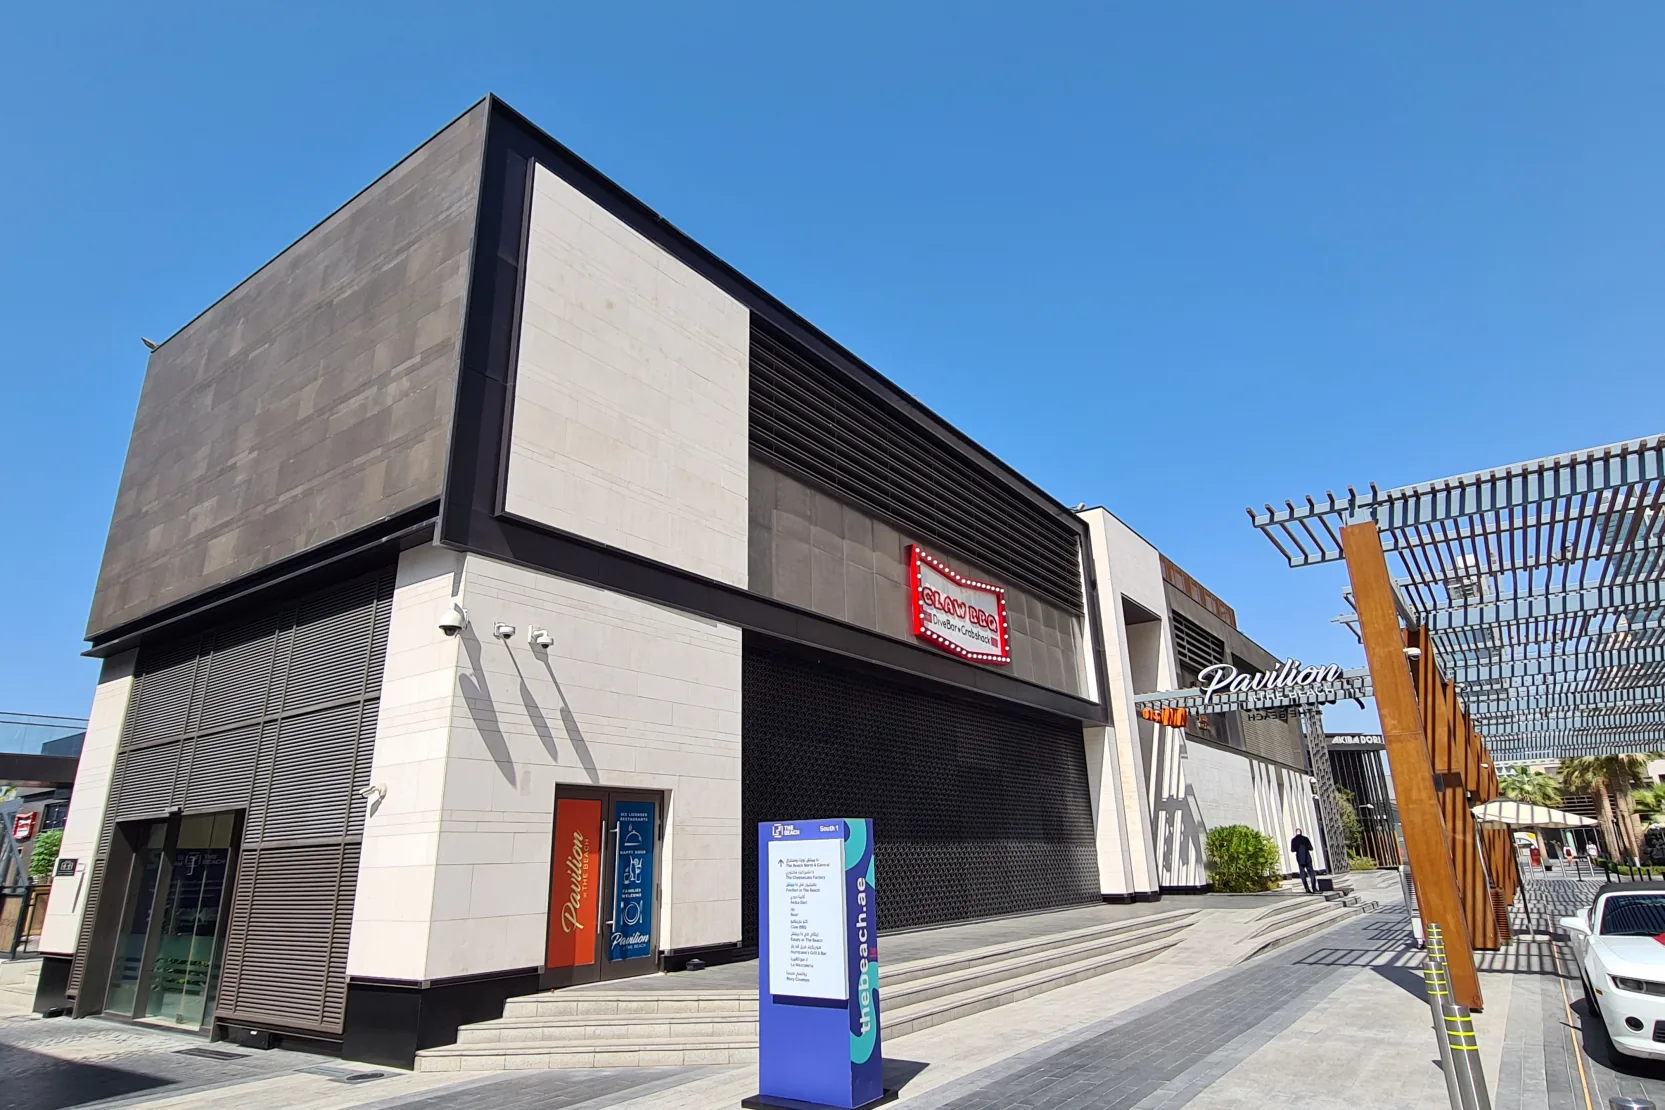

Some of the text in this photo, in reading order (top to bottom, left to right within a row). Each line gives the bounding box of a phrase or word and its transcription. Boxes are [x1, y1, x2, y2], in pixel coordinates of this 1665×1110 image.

[922, 586, 998, 633] CLAW BBQ
[1198, 657, 1342, 704] Pavilion
[1331, 735, 1382, 744] AKIBA DORI
[582, 838, 590, 870] BEACH
[561, 829, 584, 933] Pavilion
[611, 932, 649, 950] Pavilion
